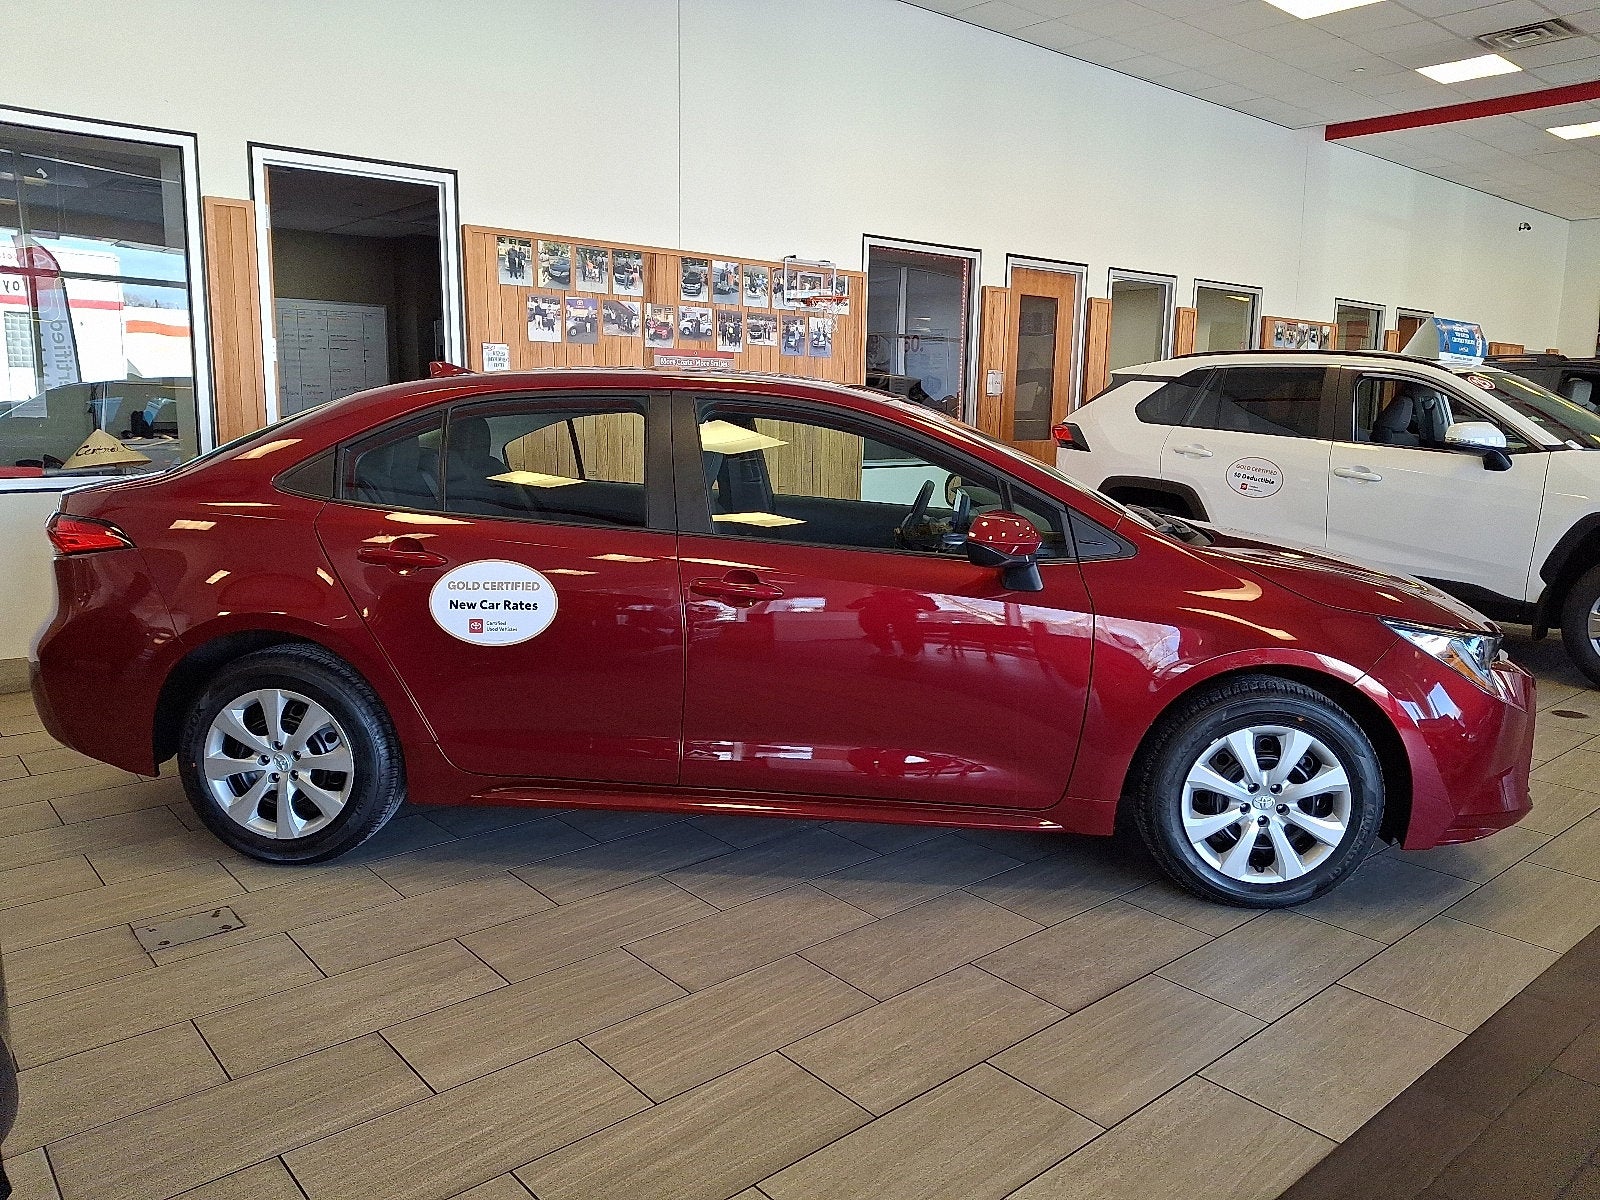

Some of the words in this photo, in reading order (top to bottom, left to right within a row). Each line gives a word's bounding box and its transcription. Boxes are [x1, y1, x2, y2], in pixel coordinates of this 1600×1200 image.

[1236, 463, 1251, 471] GOLD
[1252, 466, 1278, 476] CERTIFIED
[1241, 473, 1275, 485] Deductible
[447, 580, 480, 591] GOLD
[482, 581, 541, 592] CERTIFIED
[449, 599, 477, 610] New
[480, 599, 501, 610] Car
[503, 599, 539, 611] Rates
